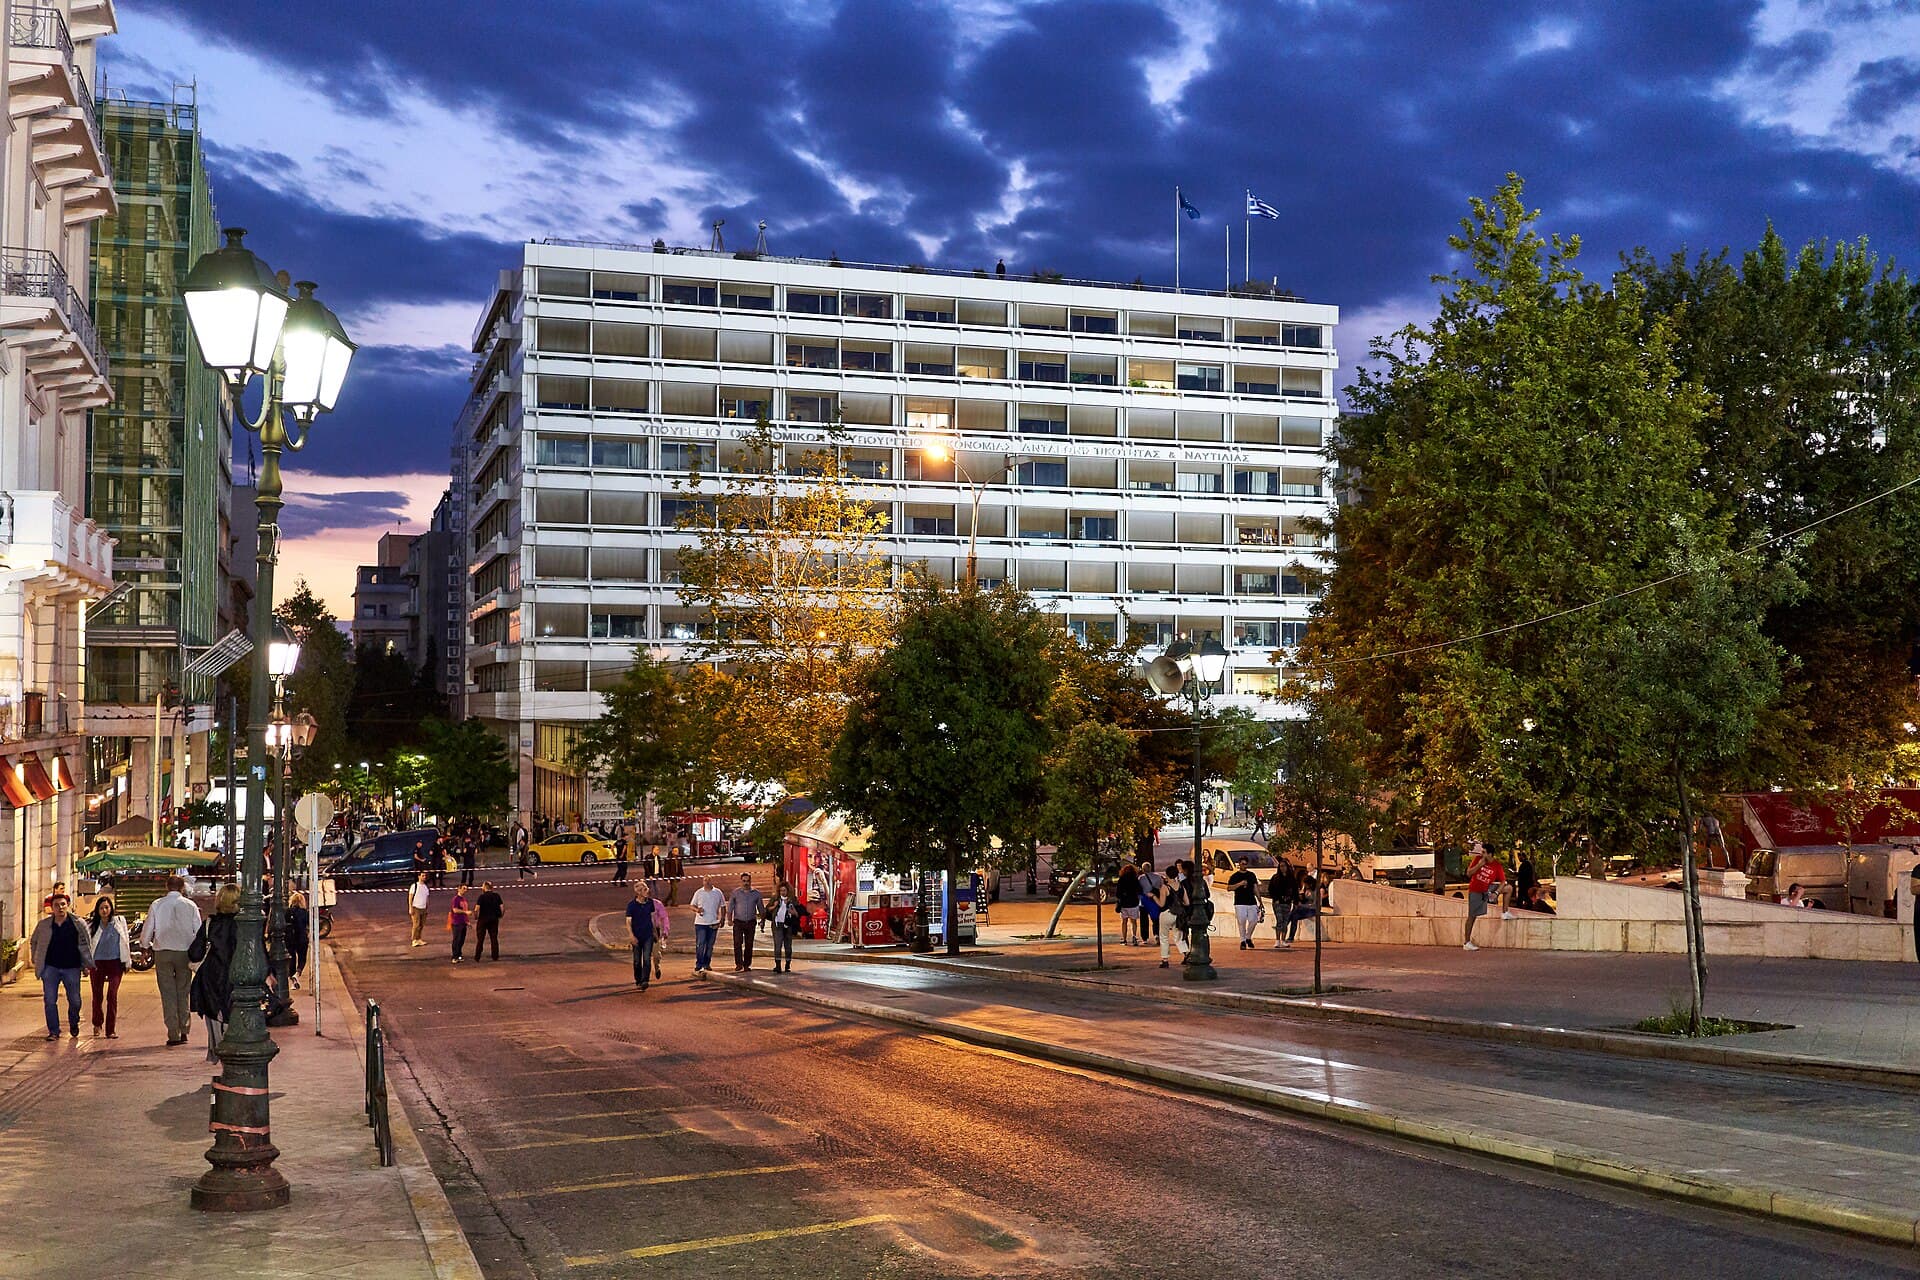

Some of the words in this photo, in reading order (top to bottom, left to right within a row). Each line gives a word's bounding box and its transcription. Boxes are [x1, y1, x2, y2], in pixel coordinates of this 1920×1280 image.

[640, 424, 720, 438] ΥΠΟΥΡΓΕΙΟ
[730, 428, 825, 443] ΟΙΚΟΜΙΚΩ
[1185, 450, 1250, 463] ΝΑΥΤΙΛΙΑΣ
